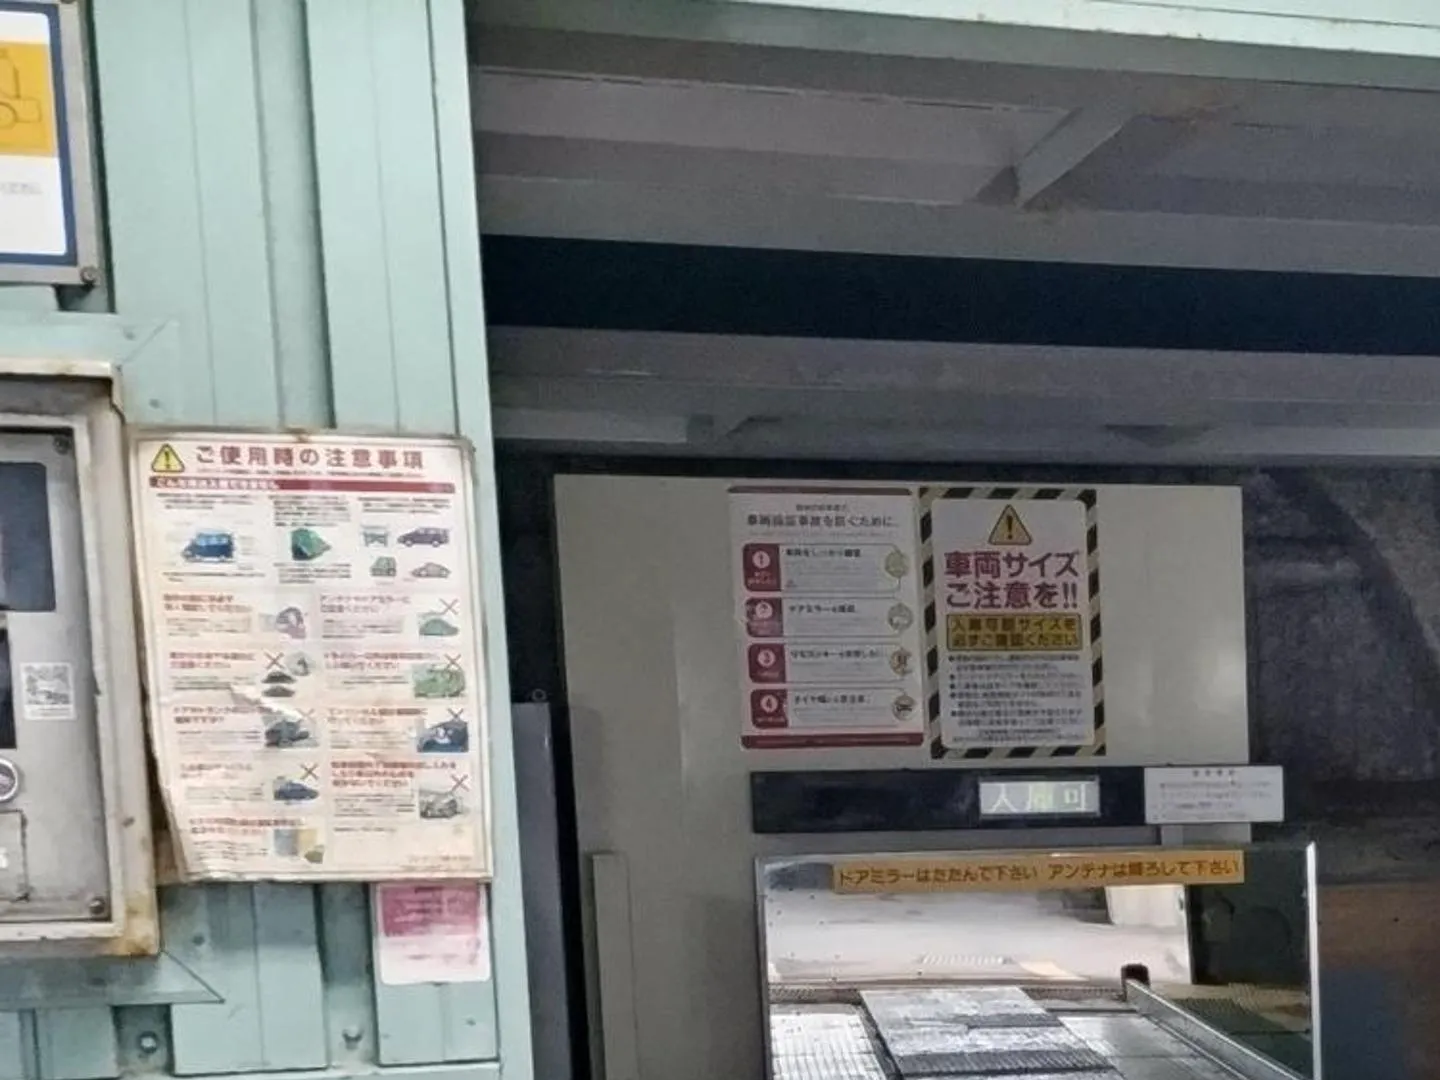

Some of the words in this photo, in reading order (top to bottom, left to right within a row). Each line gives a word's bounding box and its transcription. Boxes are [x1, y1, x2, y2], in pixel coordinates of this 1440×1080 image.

[196, 444, 423, 470] ご使用時の注意事項
[944, 551, 1080, 579] 車両サイズ
[946, 580, 1078, 610] ご注意を!!
[838, 864, 1038, 887] ドアミラーはたたんで下さい
